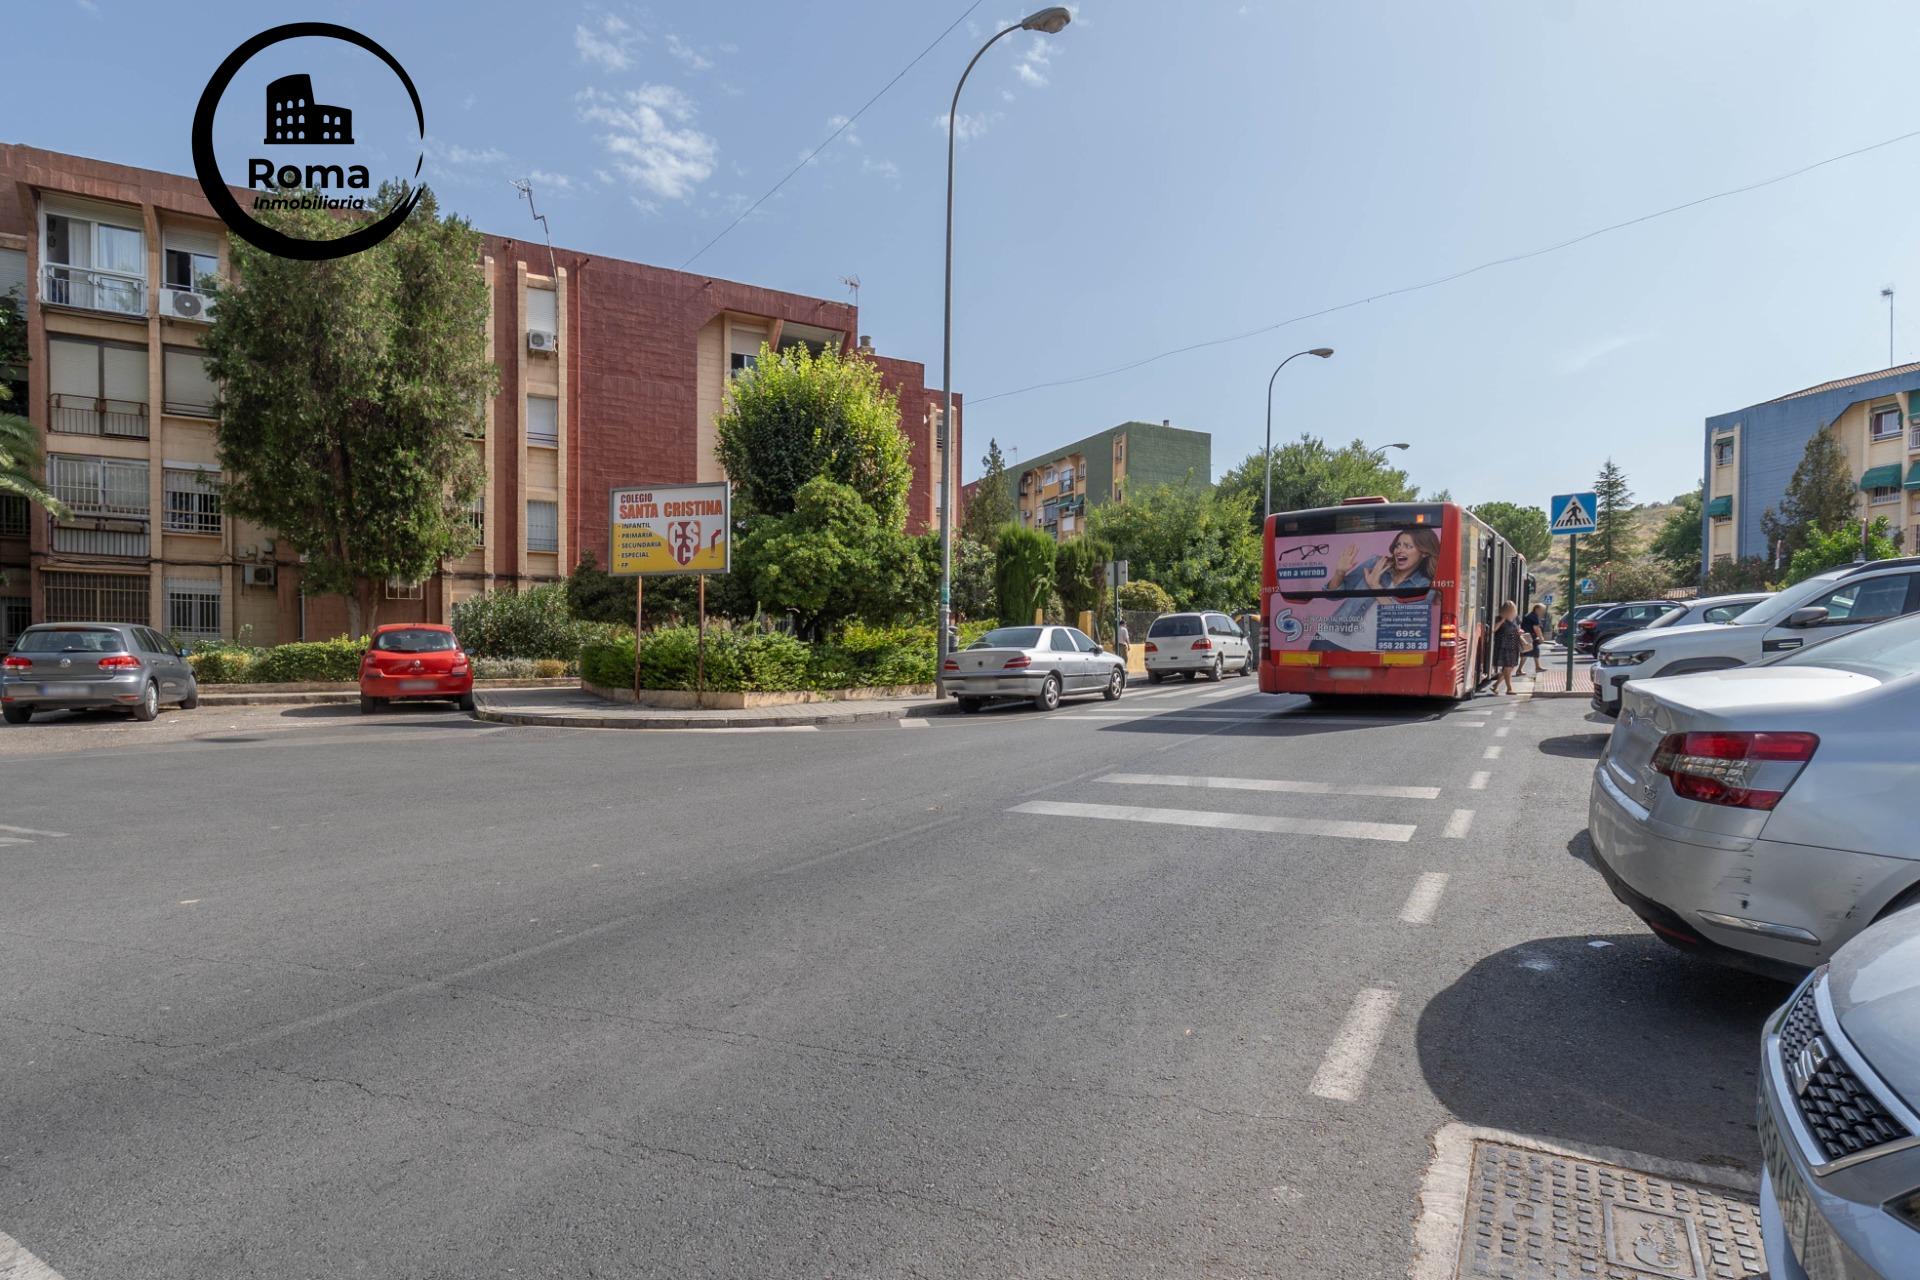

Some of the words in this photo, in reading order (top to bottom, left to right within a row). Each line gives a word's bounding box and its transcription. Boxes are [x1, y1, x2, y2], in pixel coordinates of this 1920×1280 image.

[620, 493, 653, 504] COLEGIO
[619, 503, 659, 519] SANTA
[663, 500, 723, 517] CRISTINA
[1278, 569, 1292, 577] ven
[1300, 568, 1325, 576] vernos
